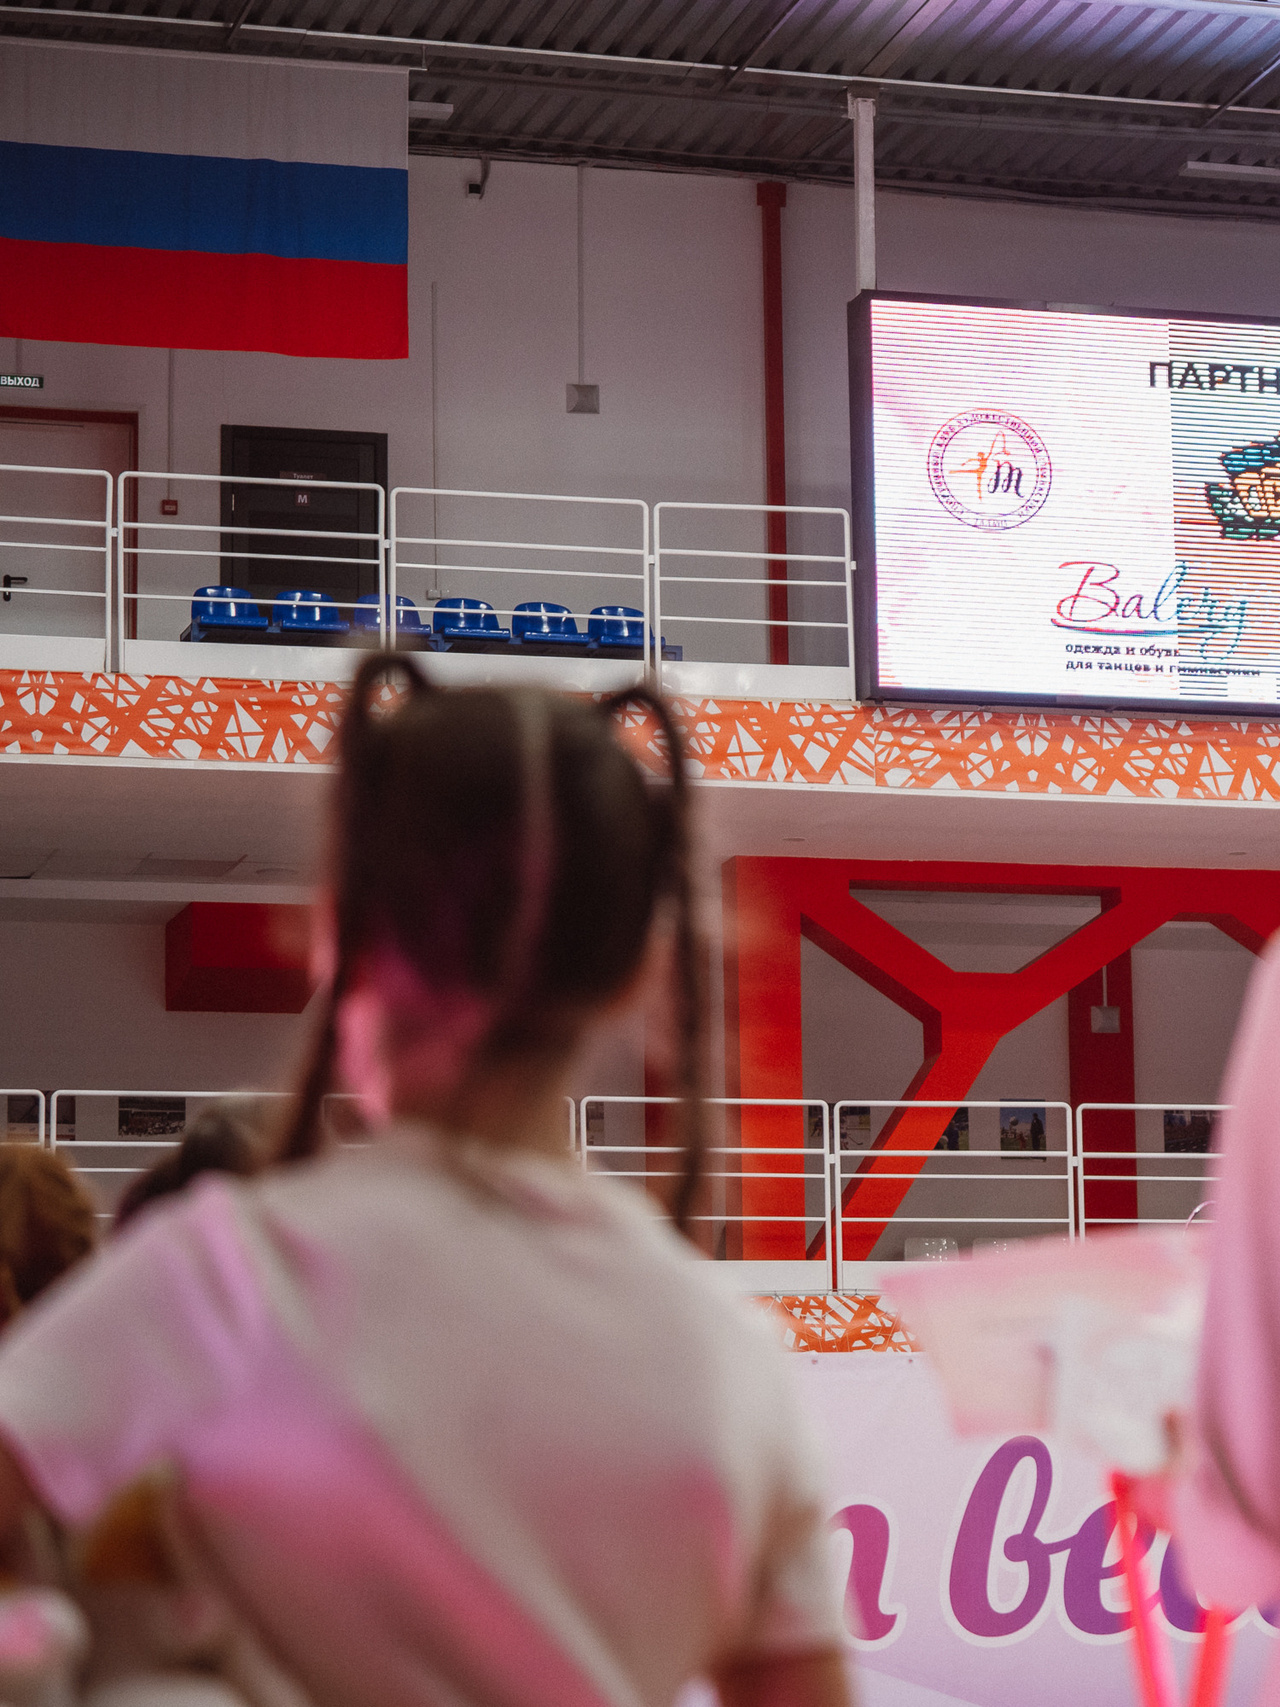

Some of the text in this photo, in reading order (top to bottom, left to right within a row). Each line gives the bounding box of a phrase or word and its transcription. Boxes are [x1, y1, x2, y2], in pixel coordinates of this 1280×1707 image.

[0, 375, 40, 388] ВЫХОД
[1065, 642, 1121, 656] одежда
[1126, 644, 1135, 656] и
[1065, 660, 1093, 671] для
[1098, 662, 1150, 674] танцев
[1155, 664, 1164, 674] и
